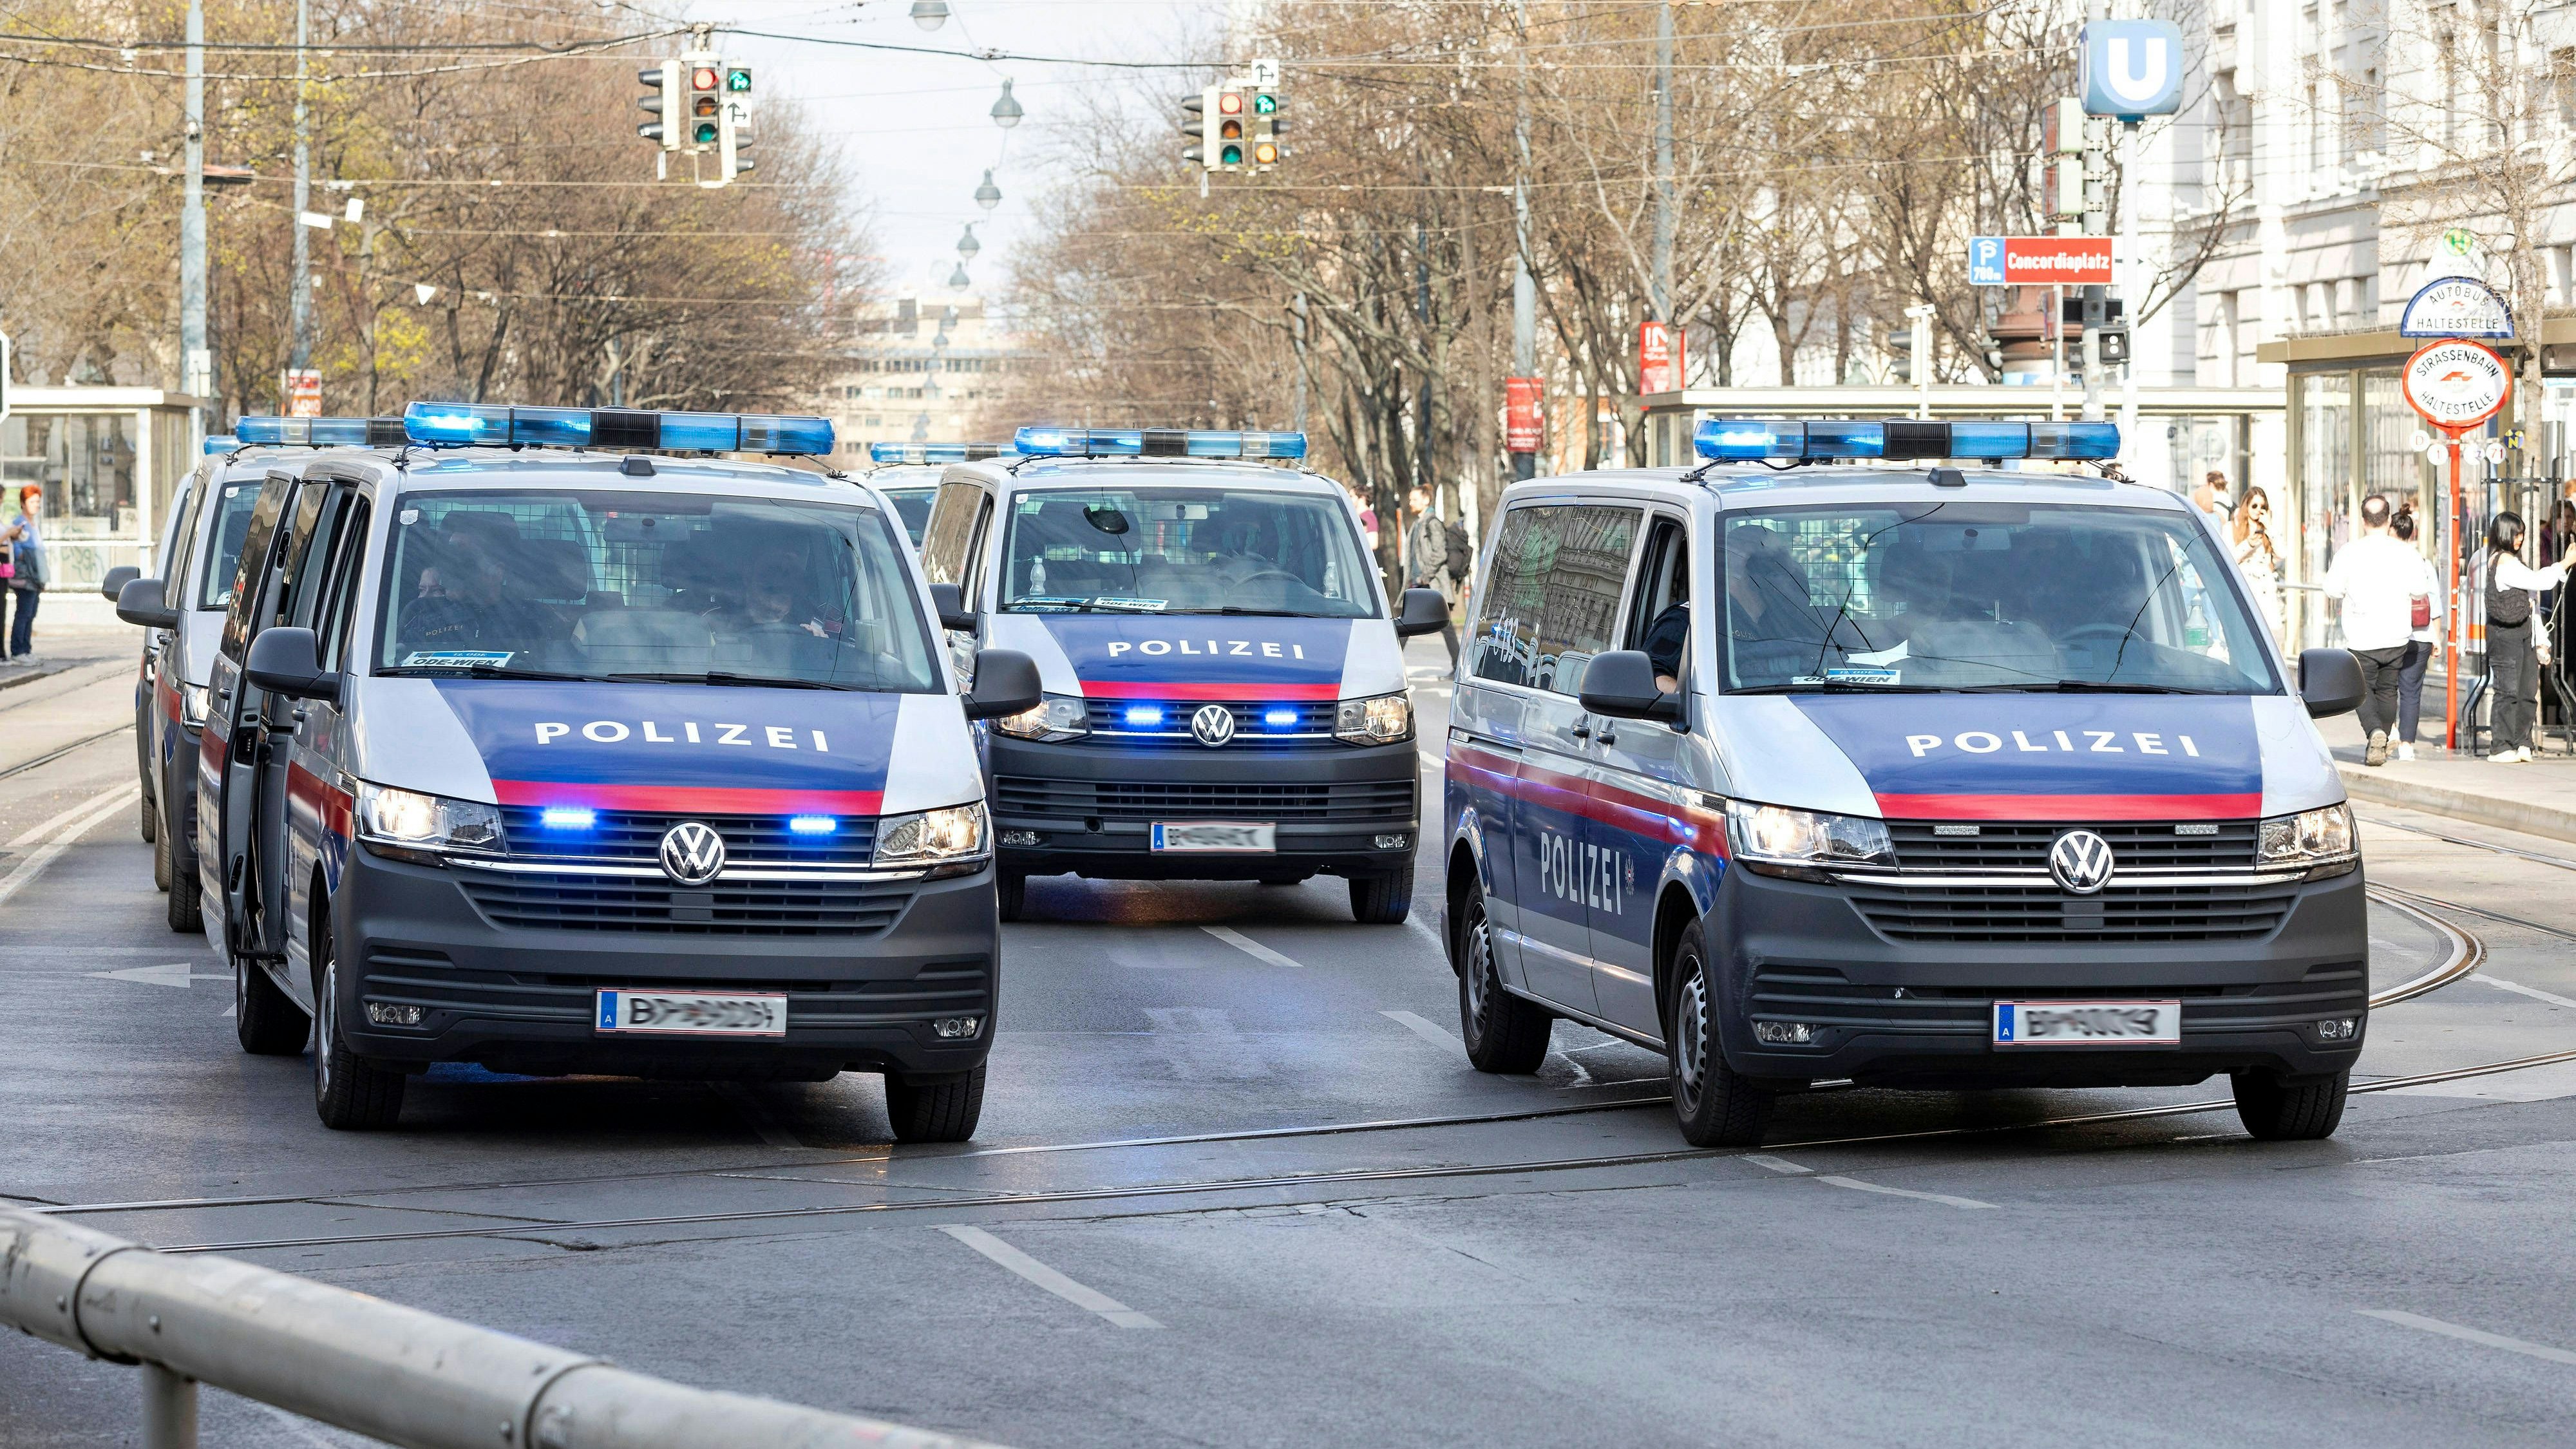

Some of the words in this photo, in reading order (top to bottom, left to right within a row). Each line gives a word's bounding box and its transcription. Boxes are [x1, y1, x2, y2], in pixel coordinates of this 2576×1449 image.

[2108, 37, 2166, 101] U
[2007, 252, 2110, 273] Concordiaplatz
[2429, 285, 2488, 307] AUTOBUS
[2417, 318, 2499, 329] HALTESTELLE
[2416, 349, 2499, 378] STRASSENBAHN
[2420, 391, 2494, 415] HALTESTELLE
[2416, 435, 2424, 446] D
[2508, 437, 2518, 448] N
[2491, 449, 2503, 460] 71
[1108, 639, 1304, 659] POLIZEI
[535, 720, 829, 753] POLIZEI
[1905, 730, 2200, 757] POLIZEI
[1540, 831, 1622, 916] POLIZEI
[605, 1014, 612, 1023] A
[2002, 1028, 2010, 1036] A
